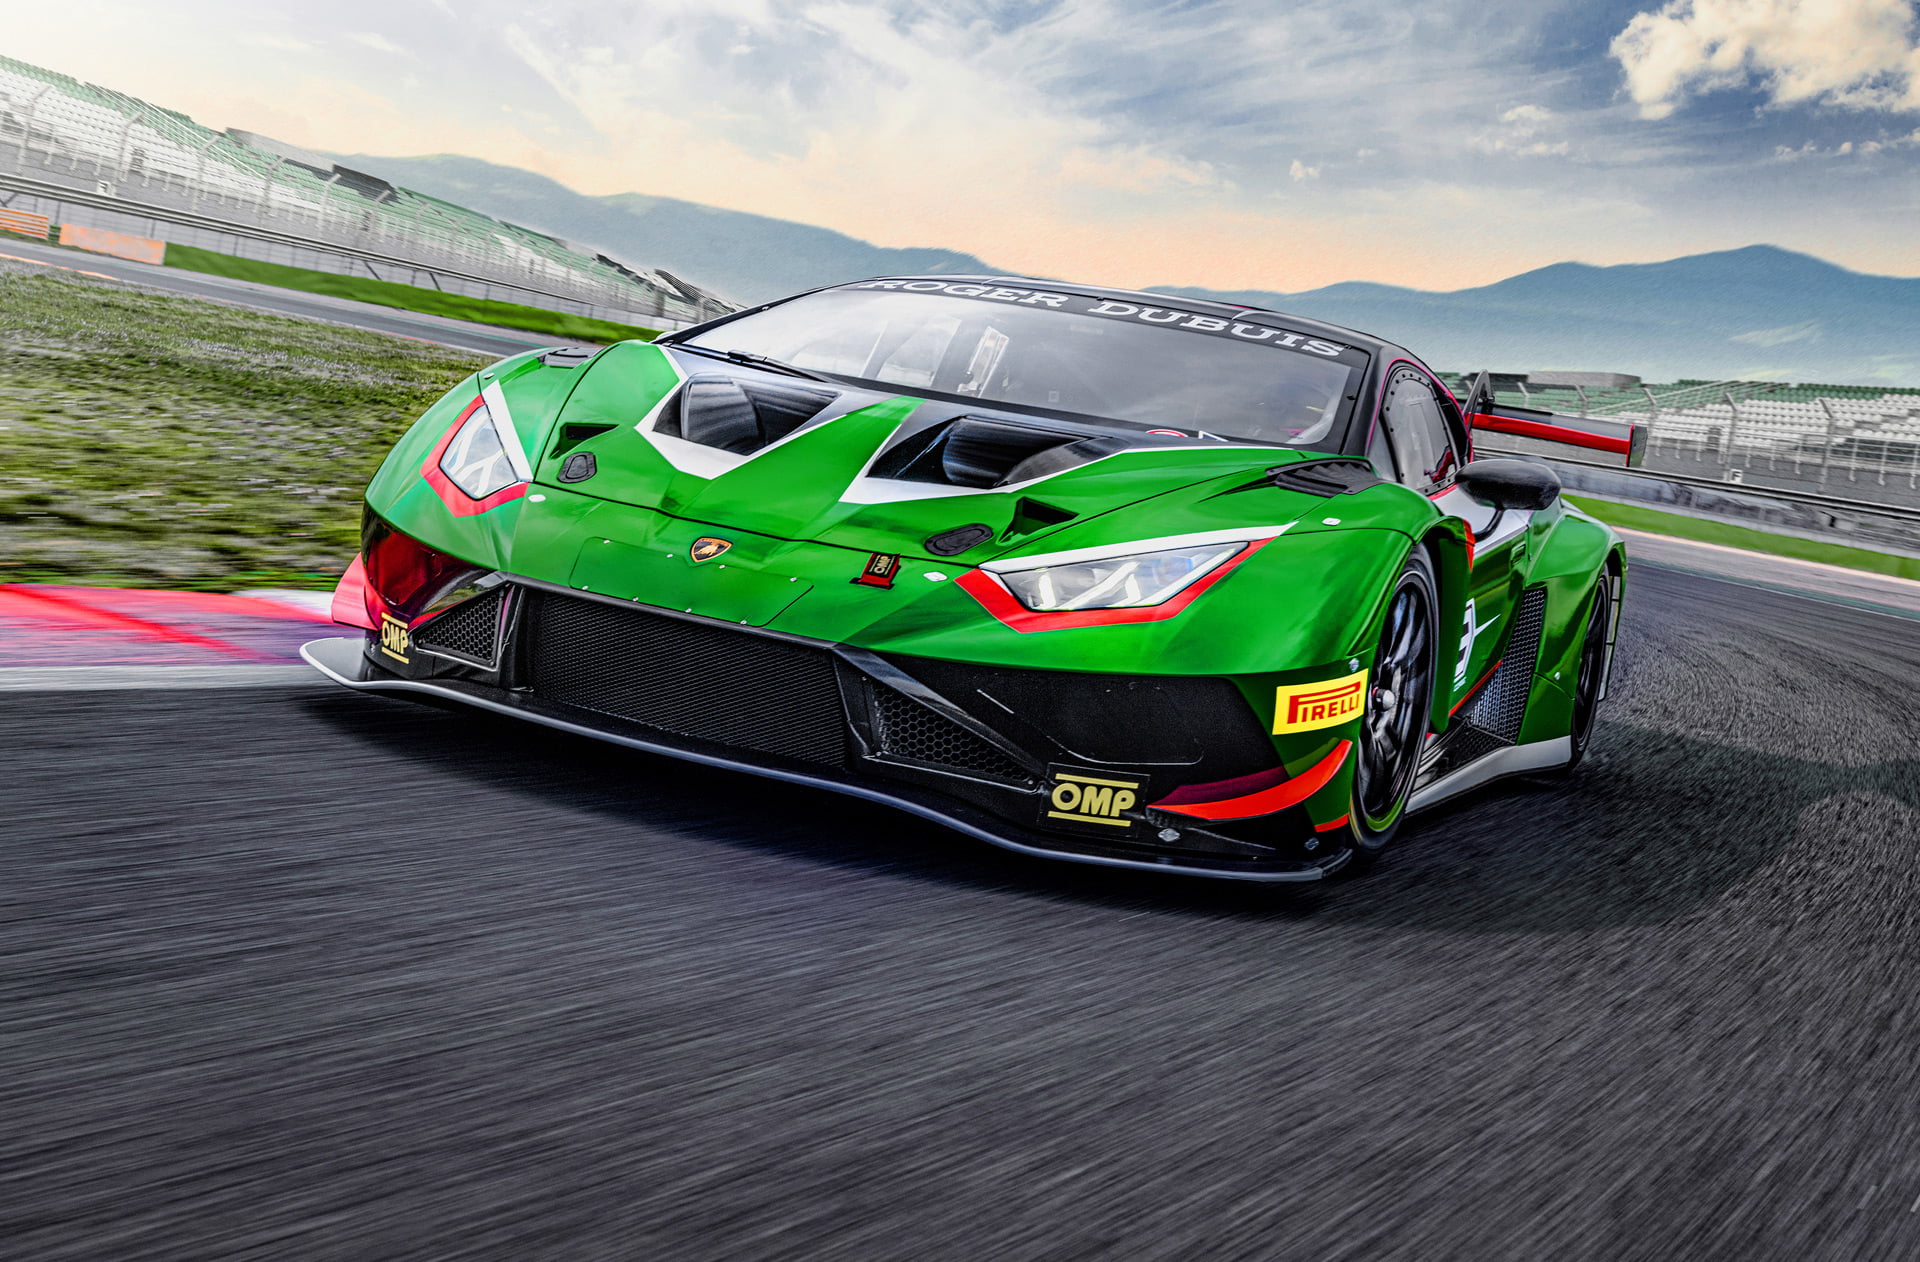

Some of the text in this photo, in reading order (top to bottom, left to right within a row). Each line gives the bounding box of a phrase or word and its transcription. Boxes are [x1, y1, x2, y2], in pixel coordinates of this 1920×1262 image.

[859, 280, 1345, 357] ROGER DUBUIS
[382, 620, 409, 654] OMP
[1287, 681, 1361, 724] PIRELLI
[1051, 782, 1136, 817] OMP
